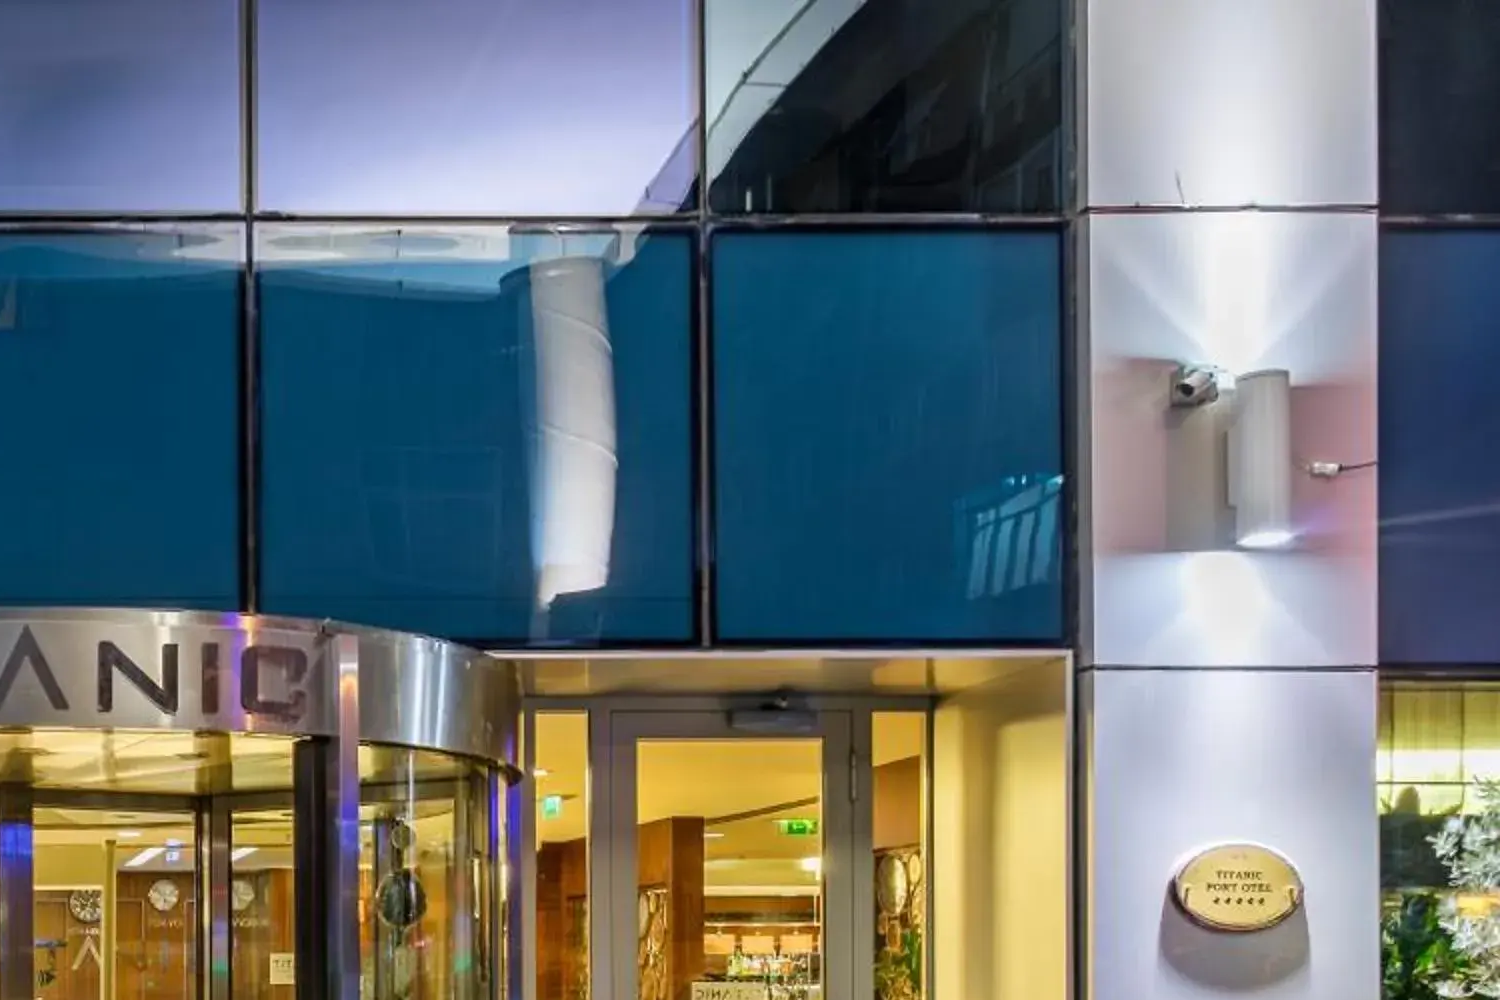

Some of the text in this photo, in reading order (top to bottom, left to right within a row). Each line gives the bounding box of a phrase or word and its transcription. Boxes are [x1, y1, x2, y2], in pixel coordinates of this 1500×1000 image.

[1216, 870, 1263, 881] TITANIC
[1206, 883, 1272, 893] PORT OTEL
